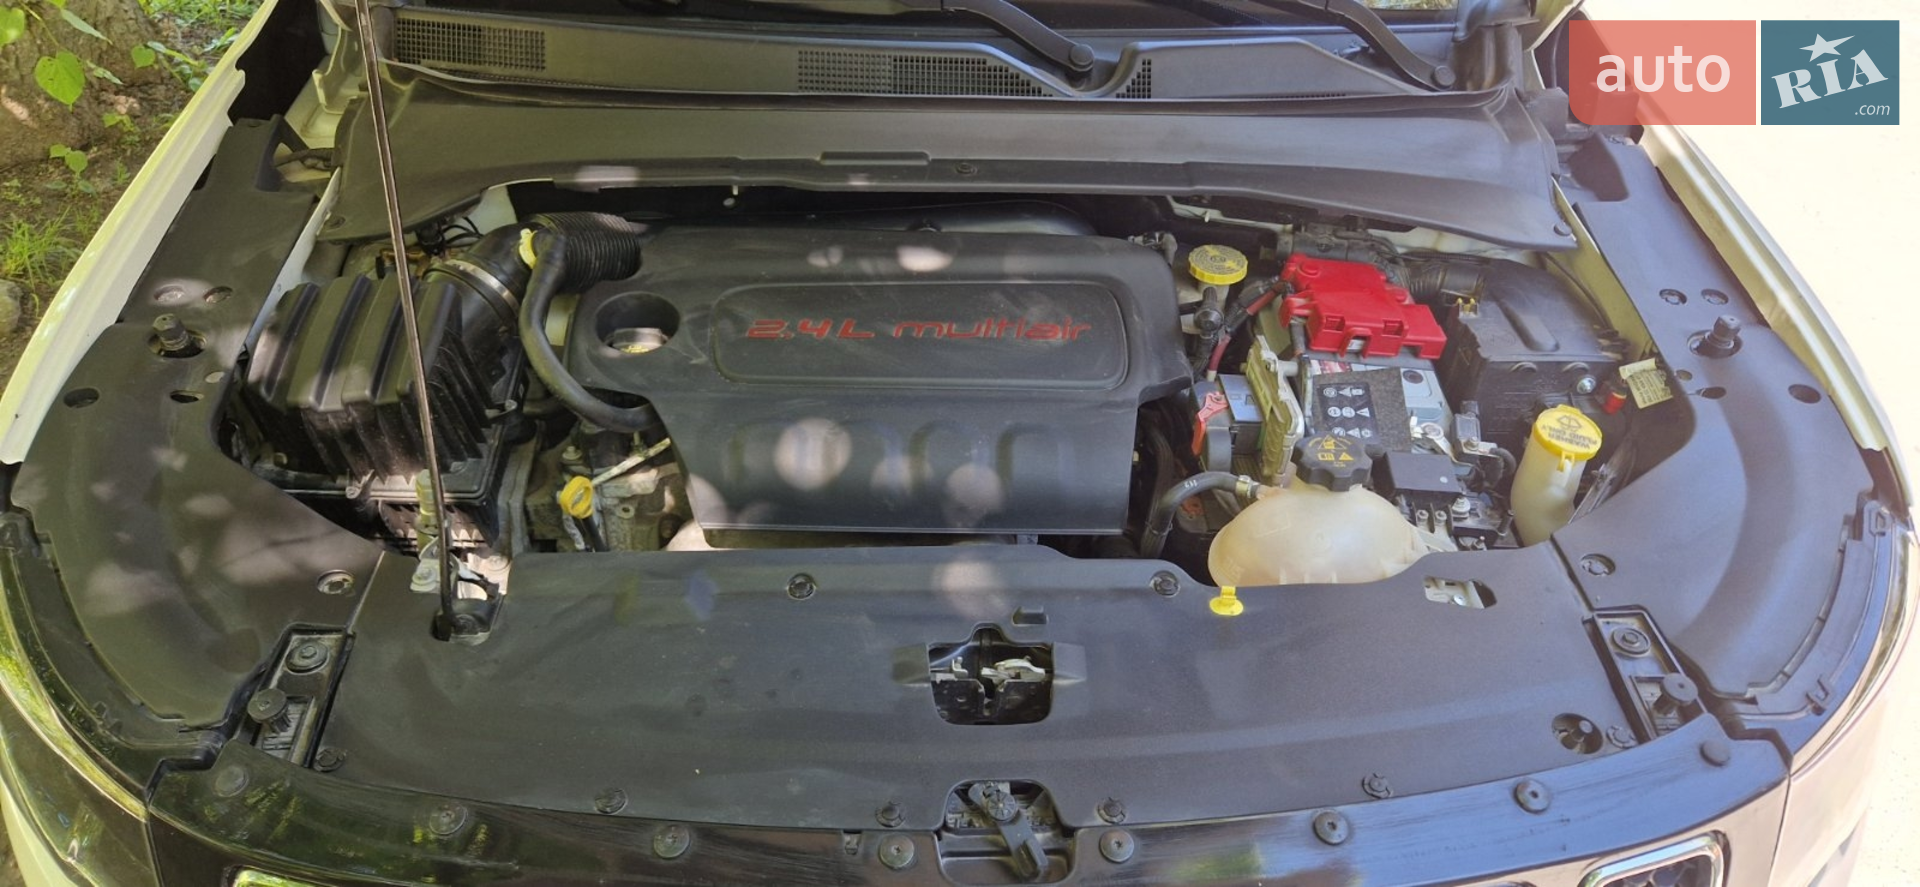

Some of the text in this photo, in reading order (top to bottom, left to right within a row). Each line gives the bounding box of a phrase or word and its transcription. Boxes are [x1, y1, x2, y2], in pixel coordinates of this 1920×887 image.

[894, 317, 1092, 339] multiair
[1548, 433, 1591, 449] WASHER
[1570, 432, 1597, 445] FLUID
